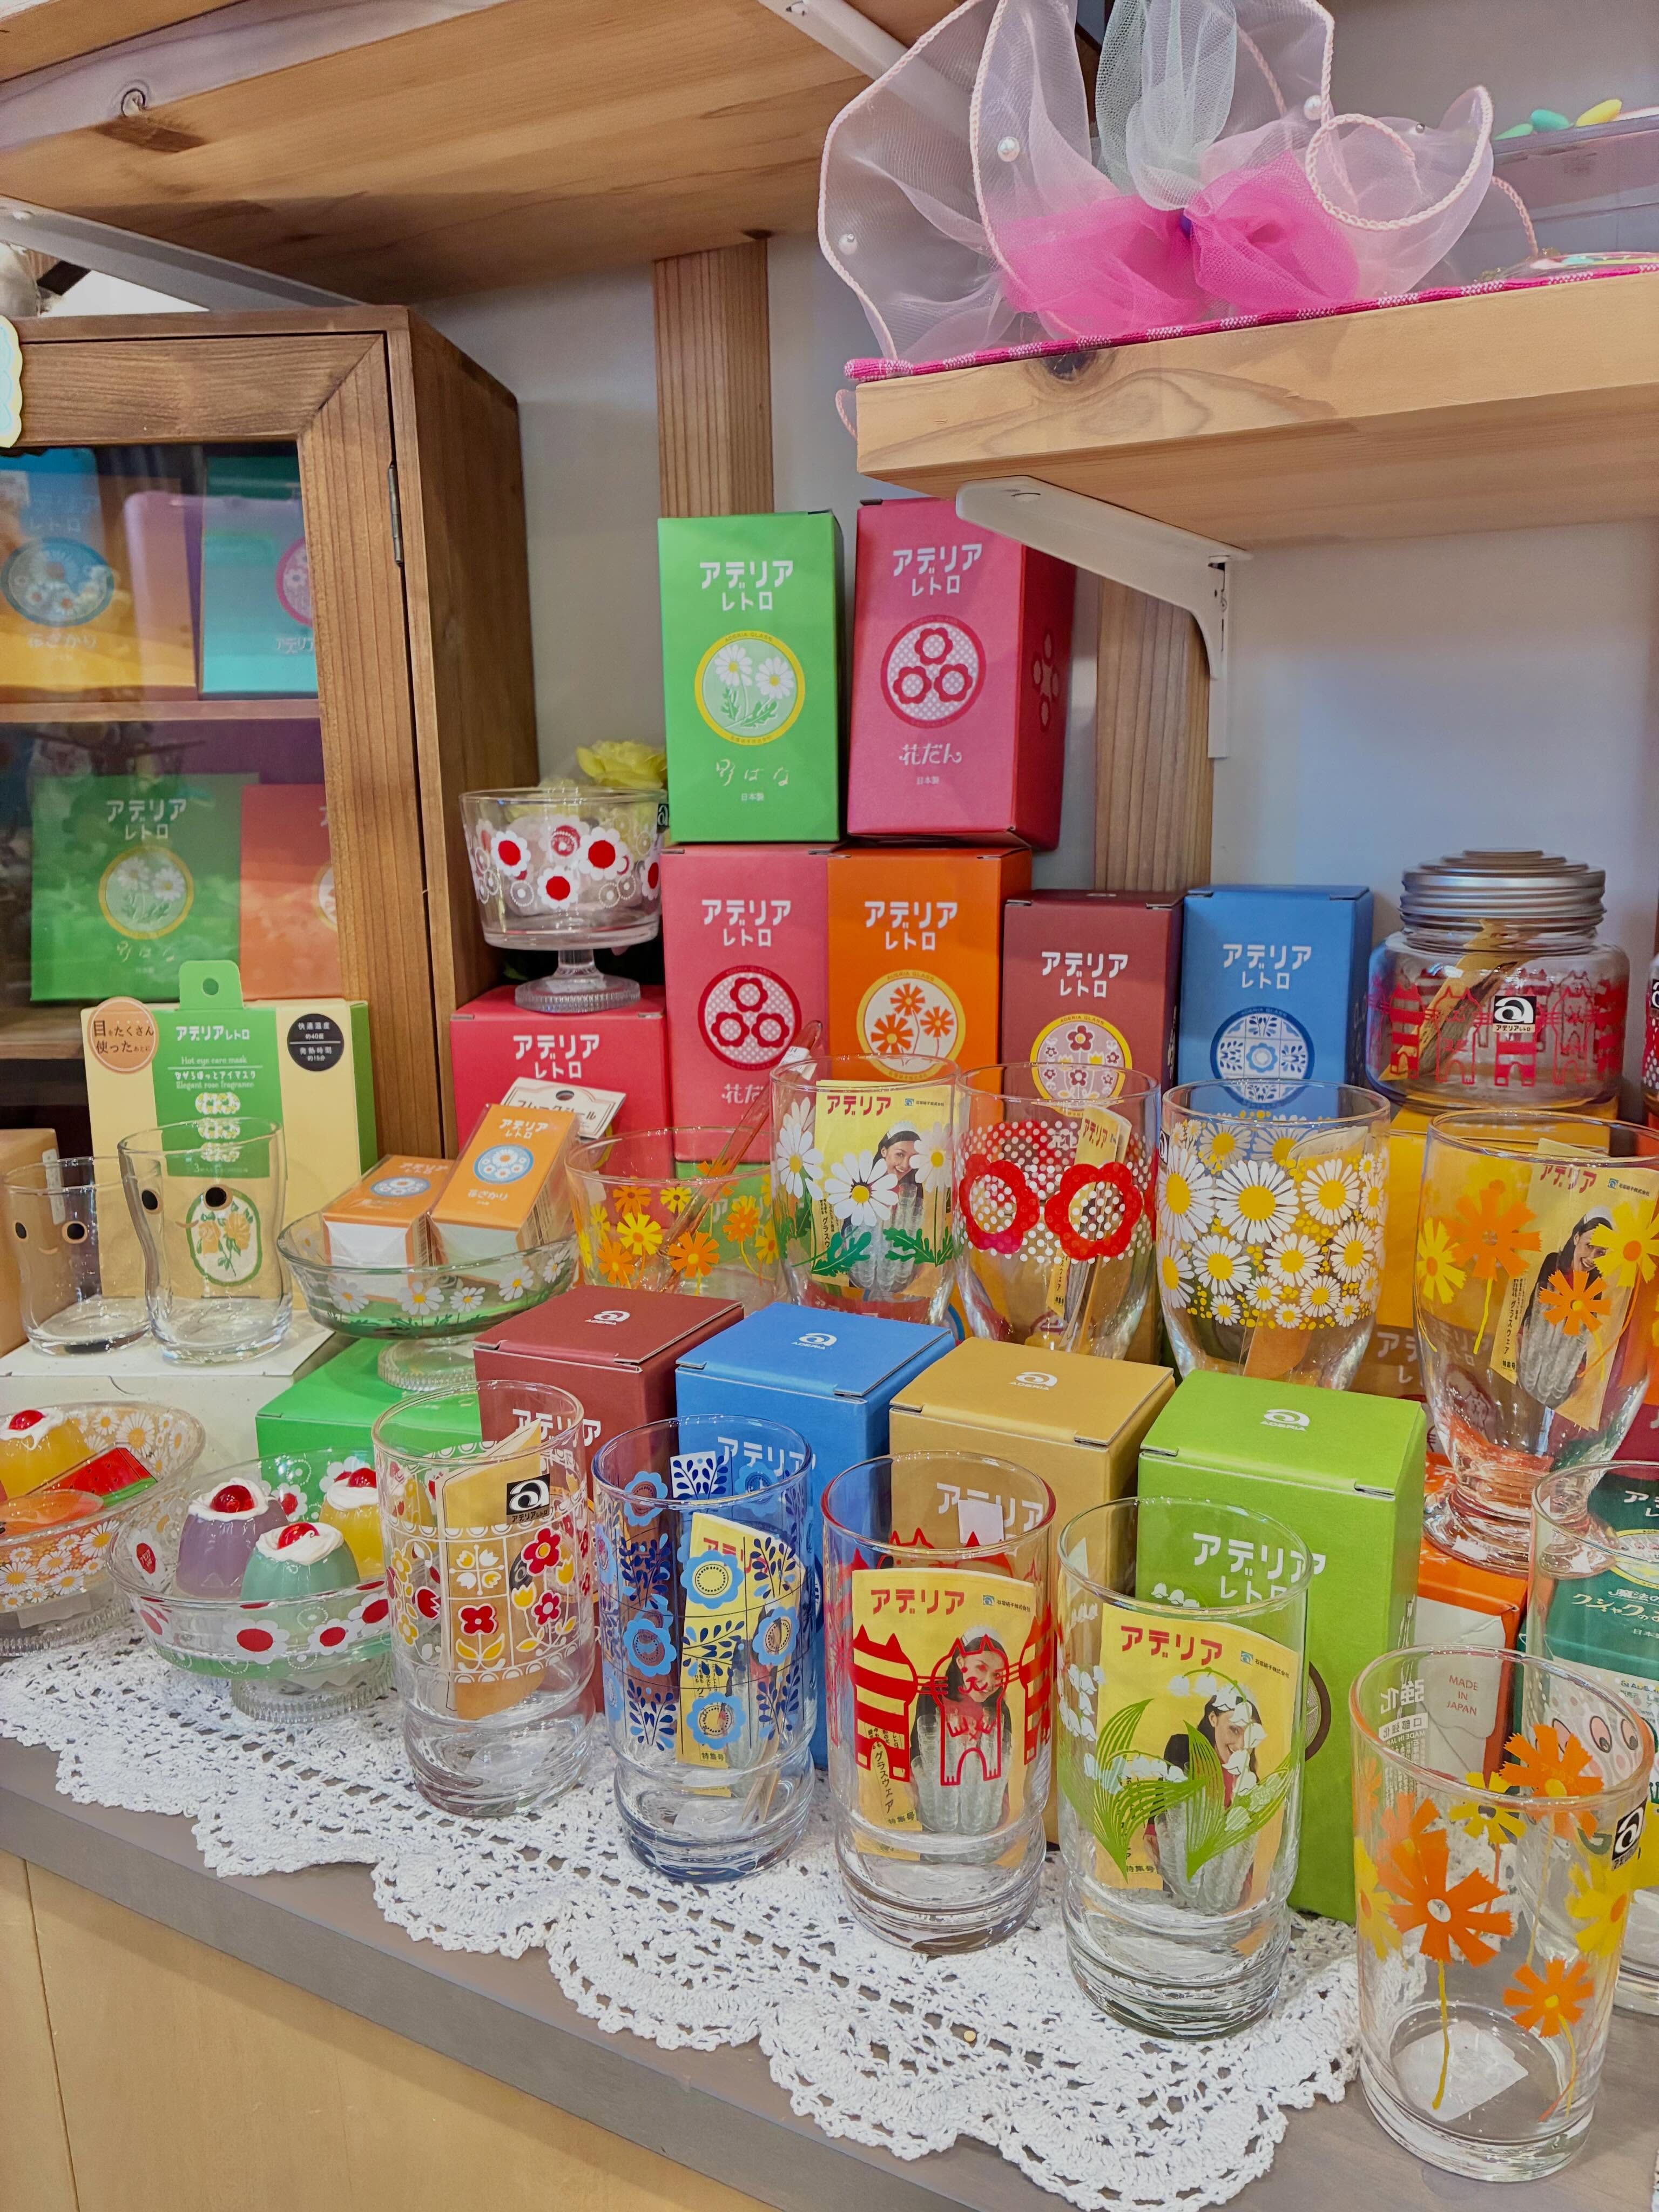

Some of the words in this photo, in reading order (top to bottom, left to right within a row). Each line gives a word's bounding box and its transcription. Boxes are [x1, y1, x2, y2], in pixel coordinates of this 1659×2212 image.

[893, 543, 982, 576] アデリア
[700, 560, 794, 590] アデリア
[911, 575, 960, 597] レトロ
[721, 591, 773, 611] レトロ
[899, 743, 962, 765] 花だん
[106, 798, 186, 822] アデリア
[125, 824, 168, 840] レトロ
[702, 900, 791, 926] アデリア
[865, 901, 957, 929] アデリア
[723, 928, 772, 947] レトロ
[885, 932, 936, 951] レトロ
[1041, 952, 1128, 979] アデリア
[1223, 944, 1312, 970] アデリア
[1059, 978, 1107, 998] レトロ
[1240, 972, 1290, 990] レトロ
[176, 1025, 250, 1041] アデリアレトロ
[513, 1035, 599, 1061] アデリア
[534, 1060, 582, 1079] レトロ
[721, 1083, 764, 1104] 花だ
[827, 1095, 891, 1116] アデリア
[498, 1118, 549, 1133] アデリア
[505, 1129, 533, 1139] レトロ
[1082, 1118, 1108, 1150] アデリア
[822, 1217, 831, 1248] グラスウ
[791, 1342, 826, 1350] ADERIA
[1007, 1381, 1049, 1391] ADERIA
[1260, 1421, 1306, 1431] ADERIA
[1193, 1532, 1326, 1583] アデリア
[871, 1589, 965, 1615] アデリア
[1121, 1626, 1223, 1665] アデリア
[1449, 1675, 1479, 1691] MADE
[1458, 1691, 1468, 1701] IN
[1447, 1701, 1477, 1716] JAPAN
[875, 1751, 894, 1813] グラスウェア
